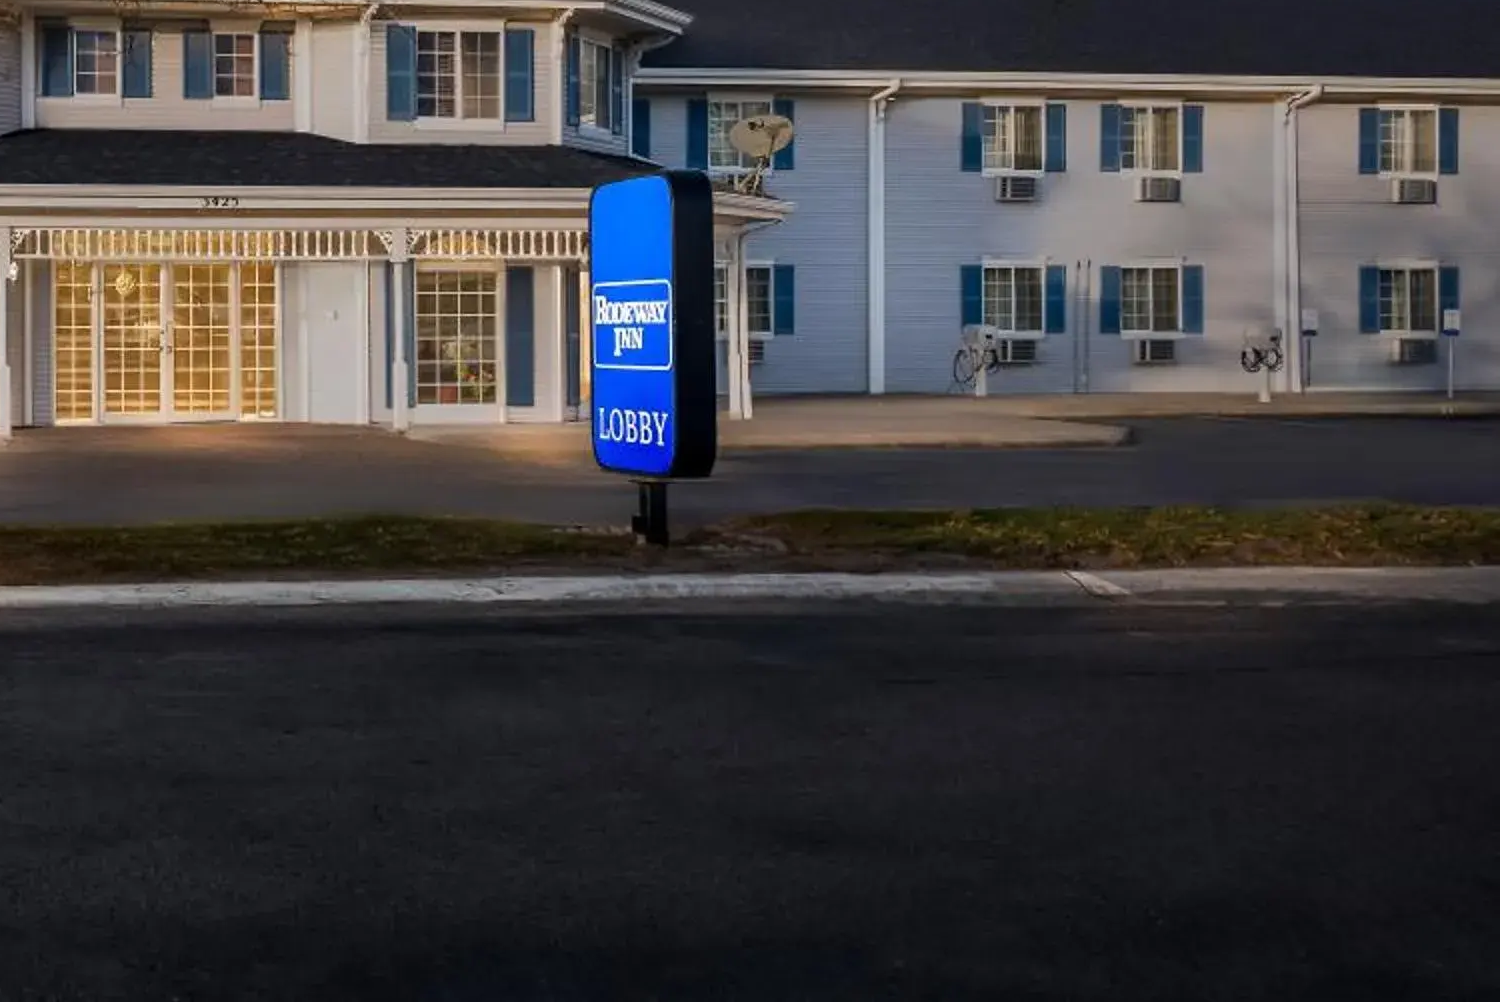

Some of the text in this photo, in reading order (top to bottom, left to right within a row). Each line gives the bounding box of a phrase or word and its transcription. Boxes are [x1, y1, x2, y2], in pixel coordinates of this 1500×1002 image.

[595, 295, 668, 325] RODEWAY
[614, 327, 643, 356] INN
[599, 408, 668, 446] LOBBY
